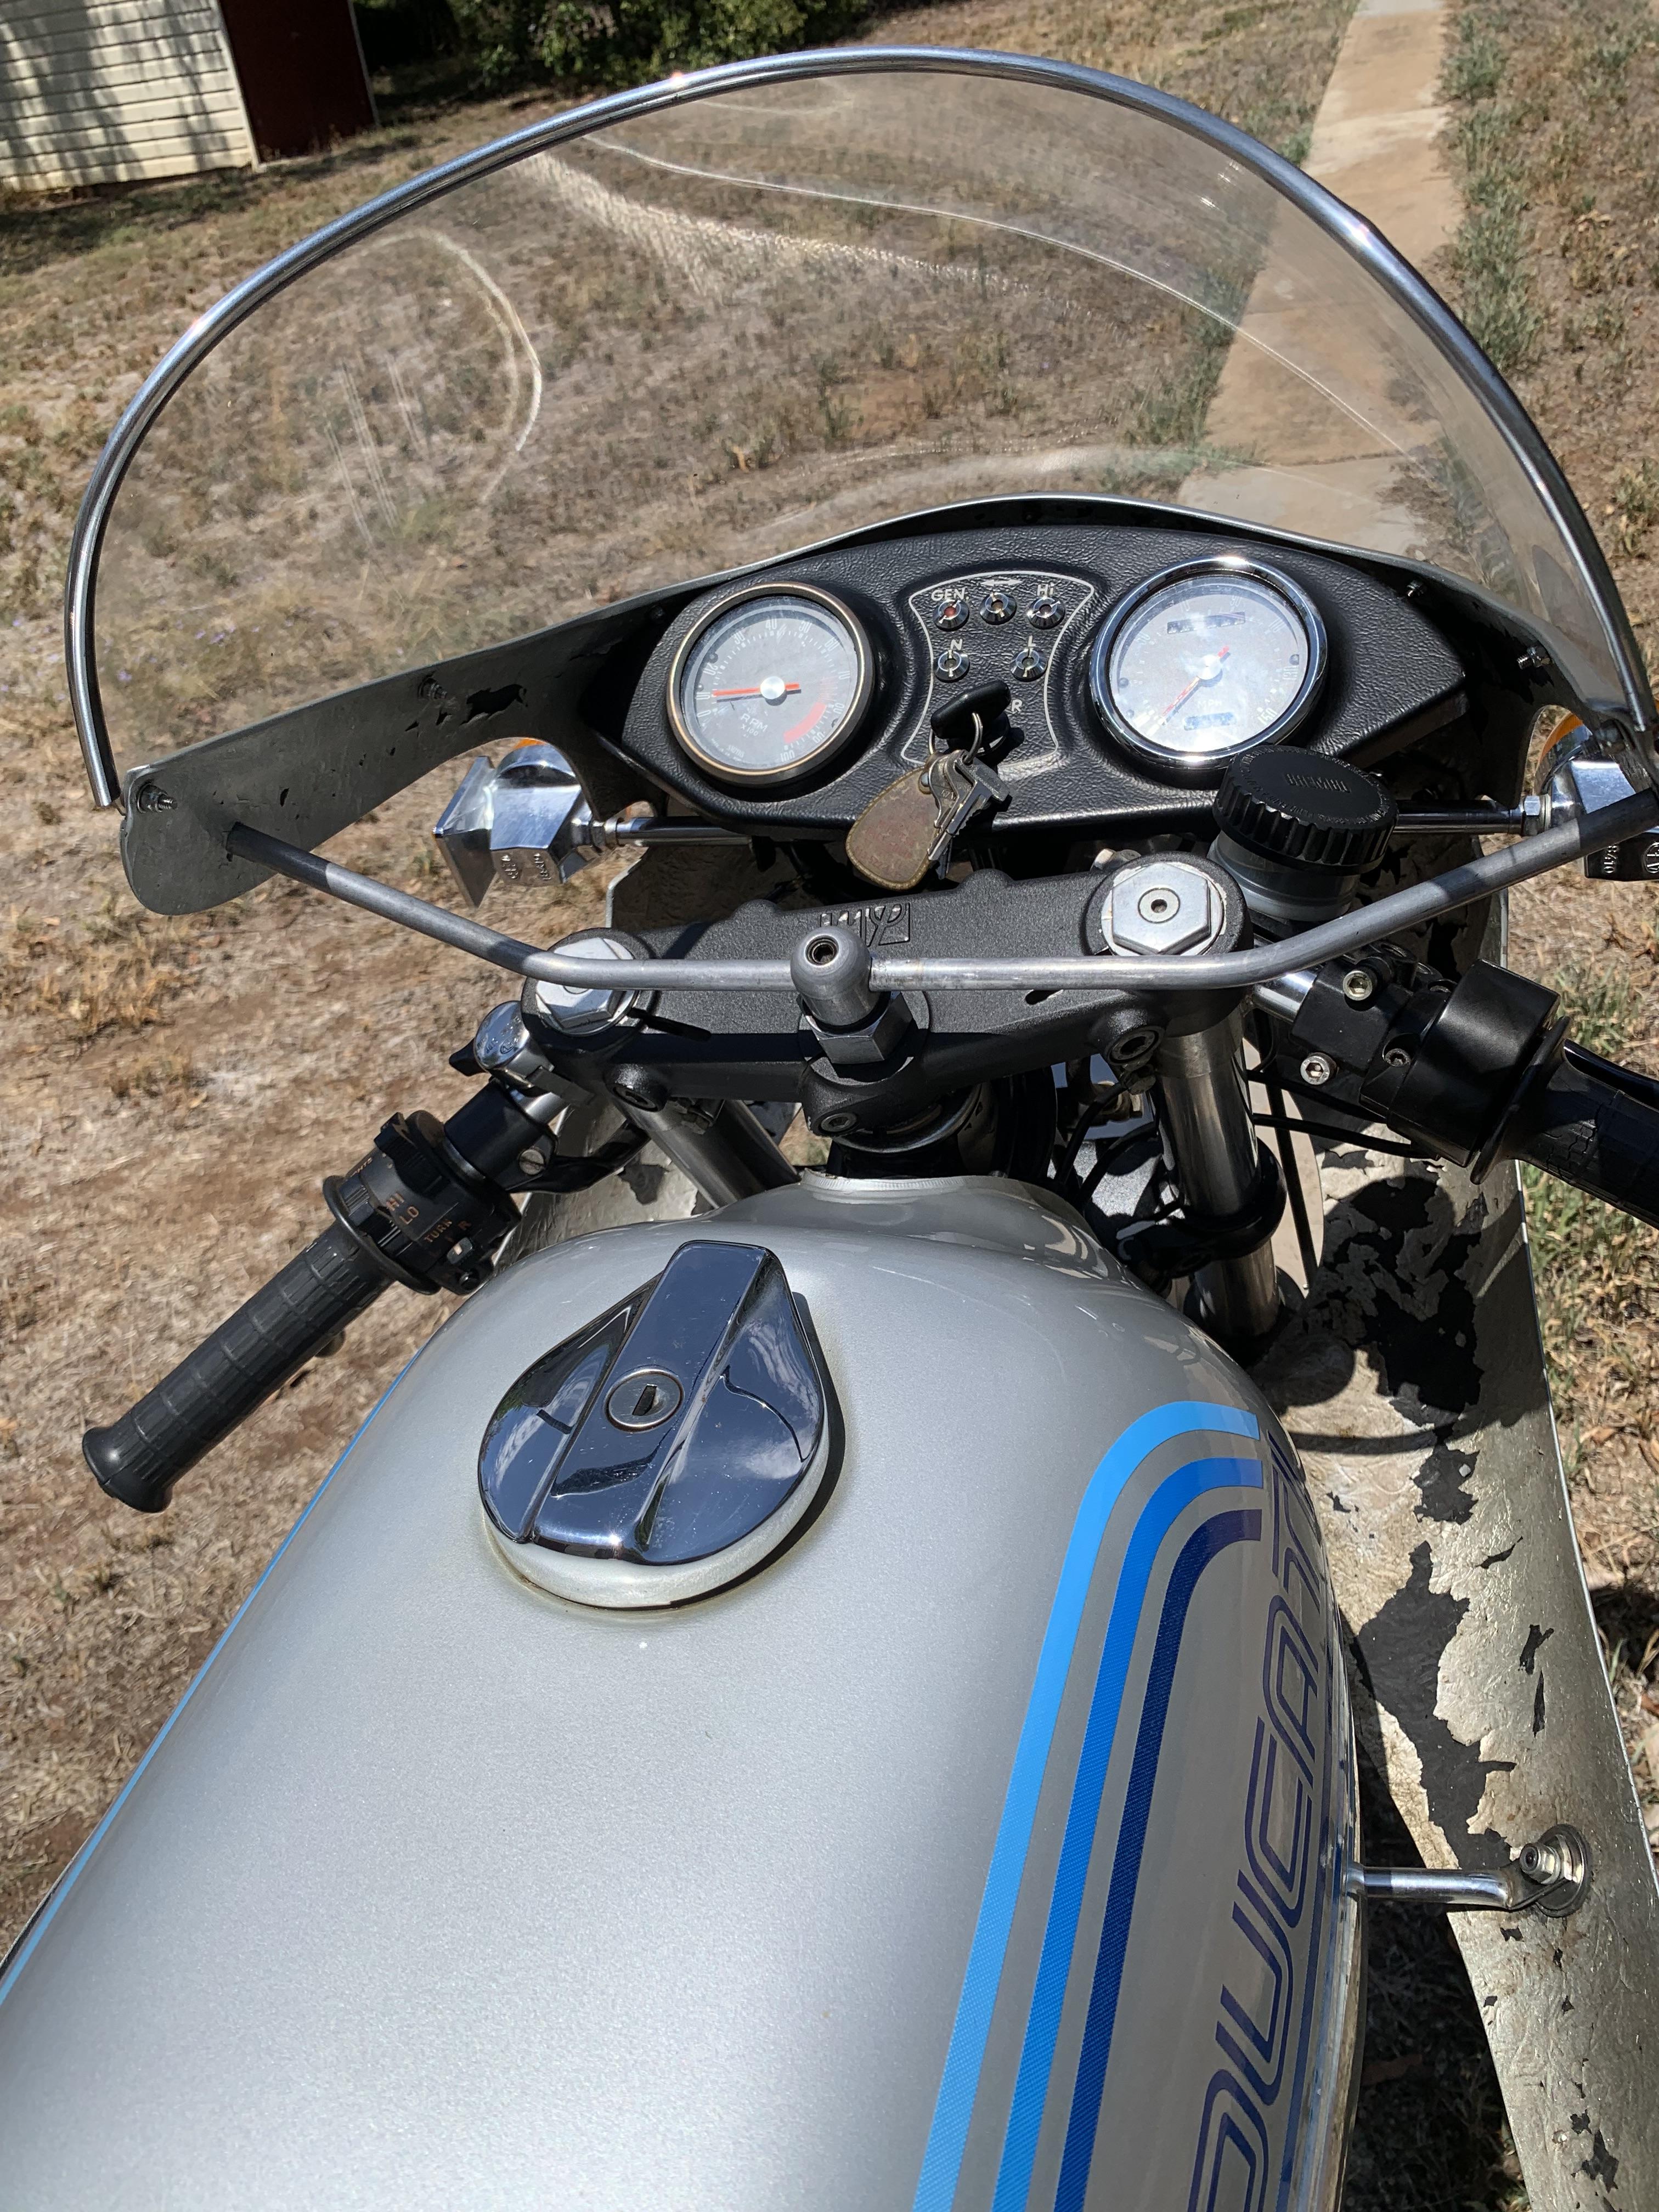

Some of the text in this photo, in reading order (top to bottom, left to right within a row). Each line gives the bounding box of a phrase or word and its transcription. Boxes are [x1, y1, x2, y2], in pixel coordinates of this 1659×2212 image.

[932, 588, 970, 601] GEN.
[1036, 583, 1055, 596] Hi
[765, 617, 777, 630] 40
[733, 630, 746, 645] 30
[1028, 635, 1036, 648] L
[950, 638, 963, 651] N
[703, 662, 719, 676] 20
[697, 710, 712, 718] 0
[741, 713, 768, 732] RPM
[399, 1206, 419, 1225] LO
